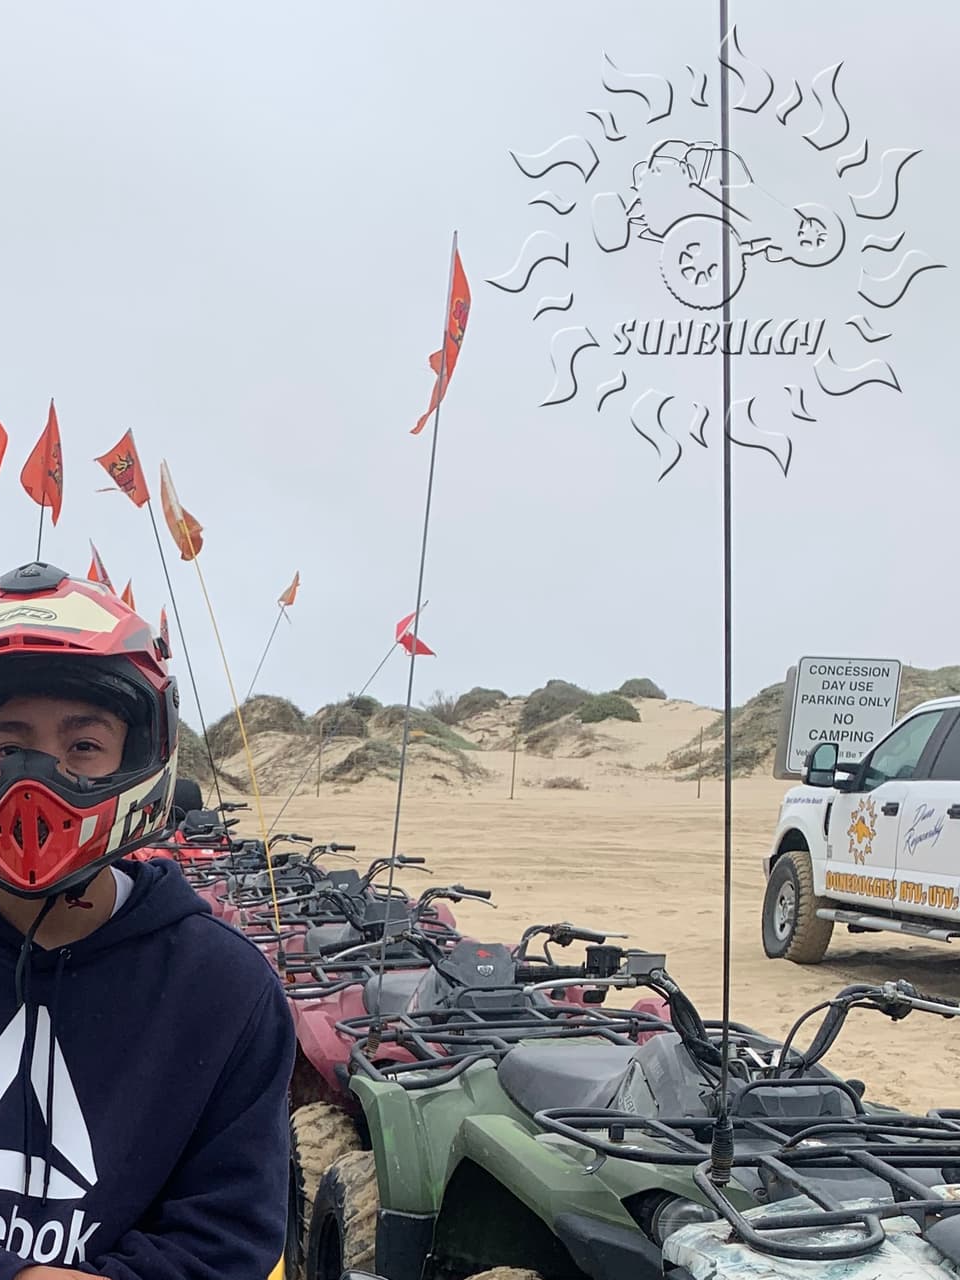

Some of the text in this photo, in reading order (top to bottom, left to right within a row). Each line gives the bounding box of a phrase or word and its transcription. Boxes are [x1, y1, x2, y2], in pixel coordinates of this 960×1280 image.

[809, 664, 890, 678] CONCESSION
[821, 679, 874, 692] DAY USE
[801, 694, 891, 708] PARKING ONLY
[833, 713, 854, 726] NO
[808, 729, 875, 744] CAMPING
[826, 870, 897, 899] DUNEBUGGIES
